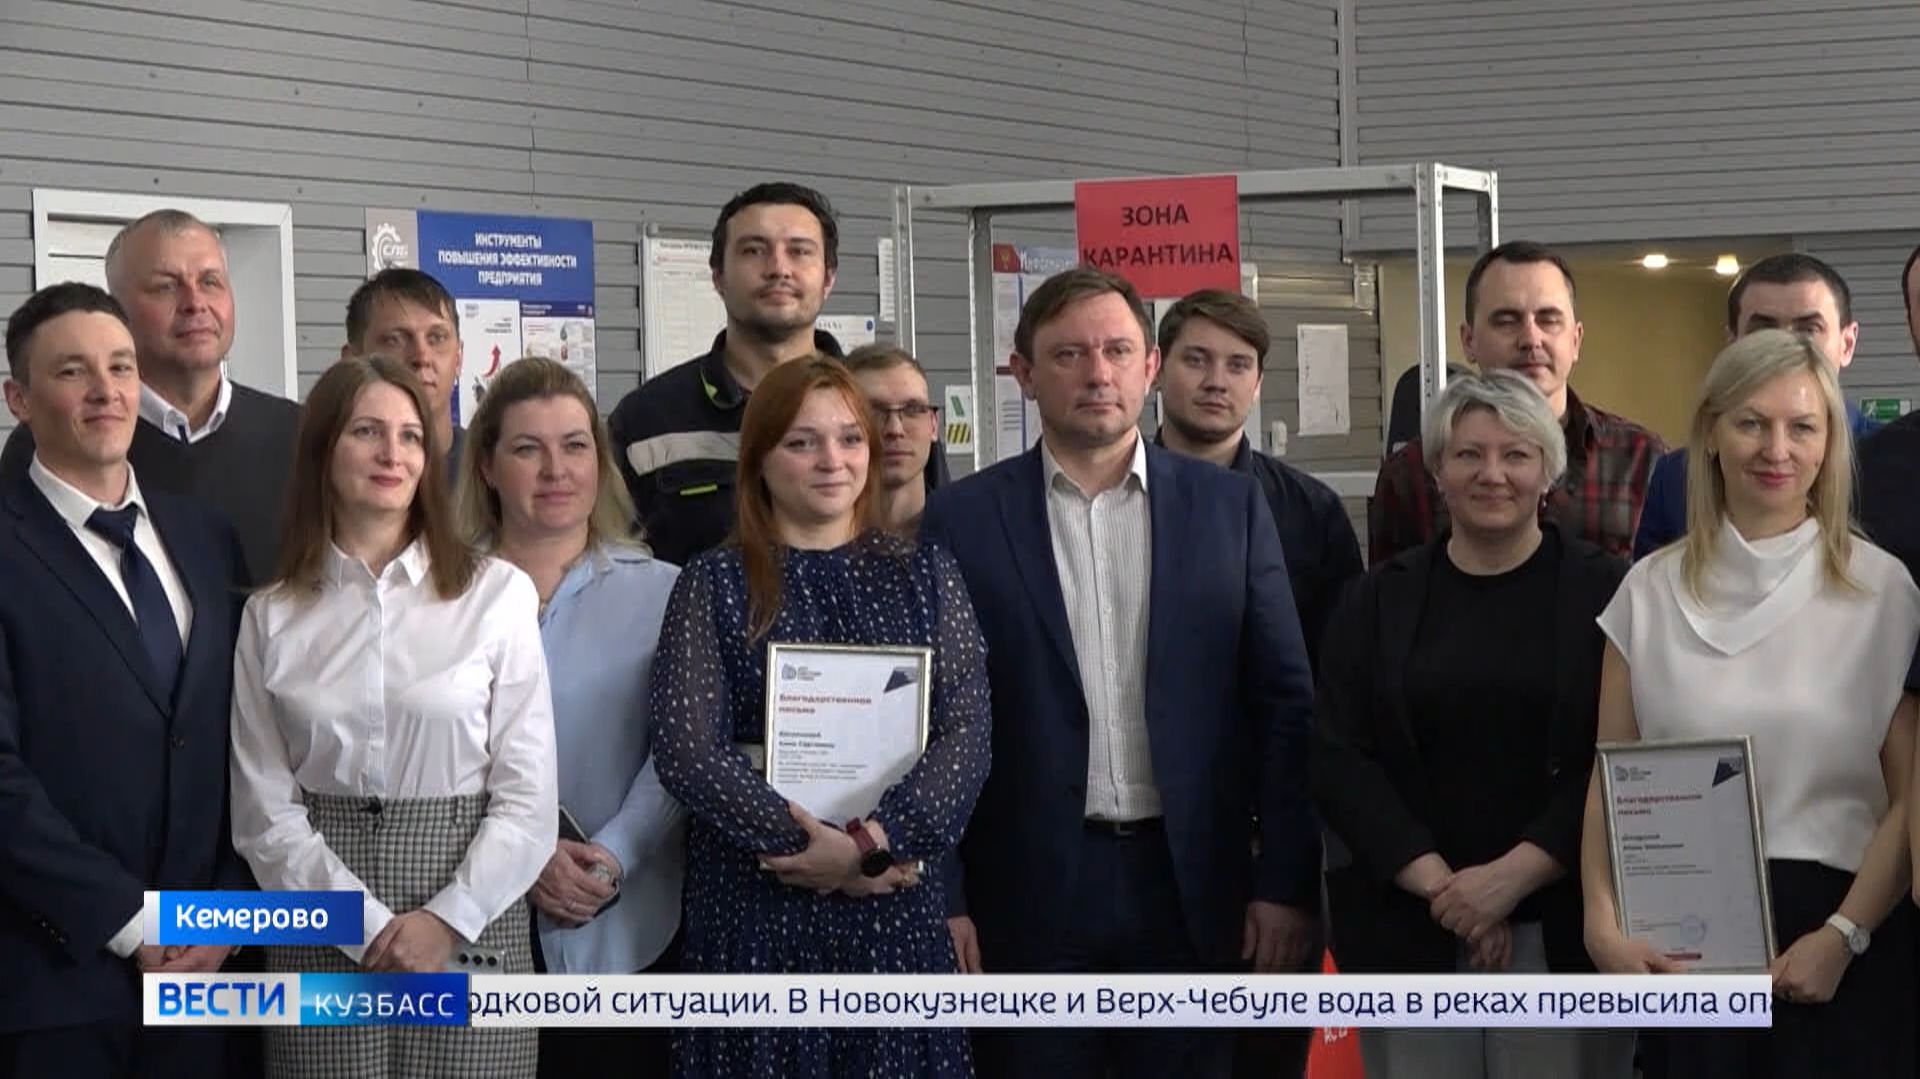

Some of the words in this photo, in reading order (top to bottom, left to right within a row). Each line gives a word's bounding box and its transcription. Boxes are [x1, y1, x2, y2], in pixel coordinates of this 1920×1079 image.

[1122, 204, 1190, 226] ЗОНА
[475, 233, 542, 249] ИНСТРУМЕНТЫ
[438, 249, 499, 267] ПОВЫШЕНИЯ
[500, 252, 577, 268] ЭФФЕКТИВНОСТИ
[1082, 243, 1233, 268] КАРАНТИНА
[478, 271, 542, 286] ПРЕДПРИЯТИЯ
[779, 693, 872, 705] Благодарственное
